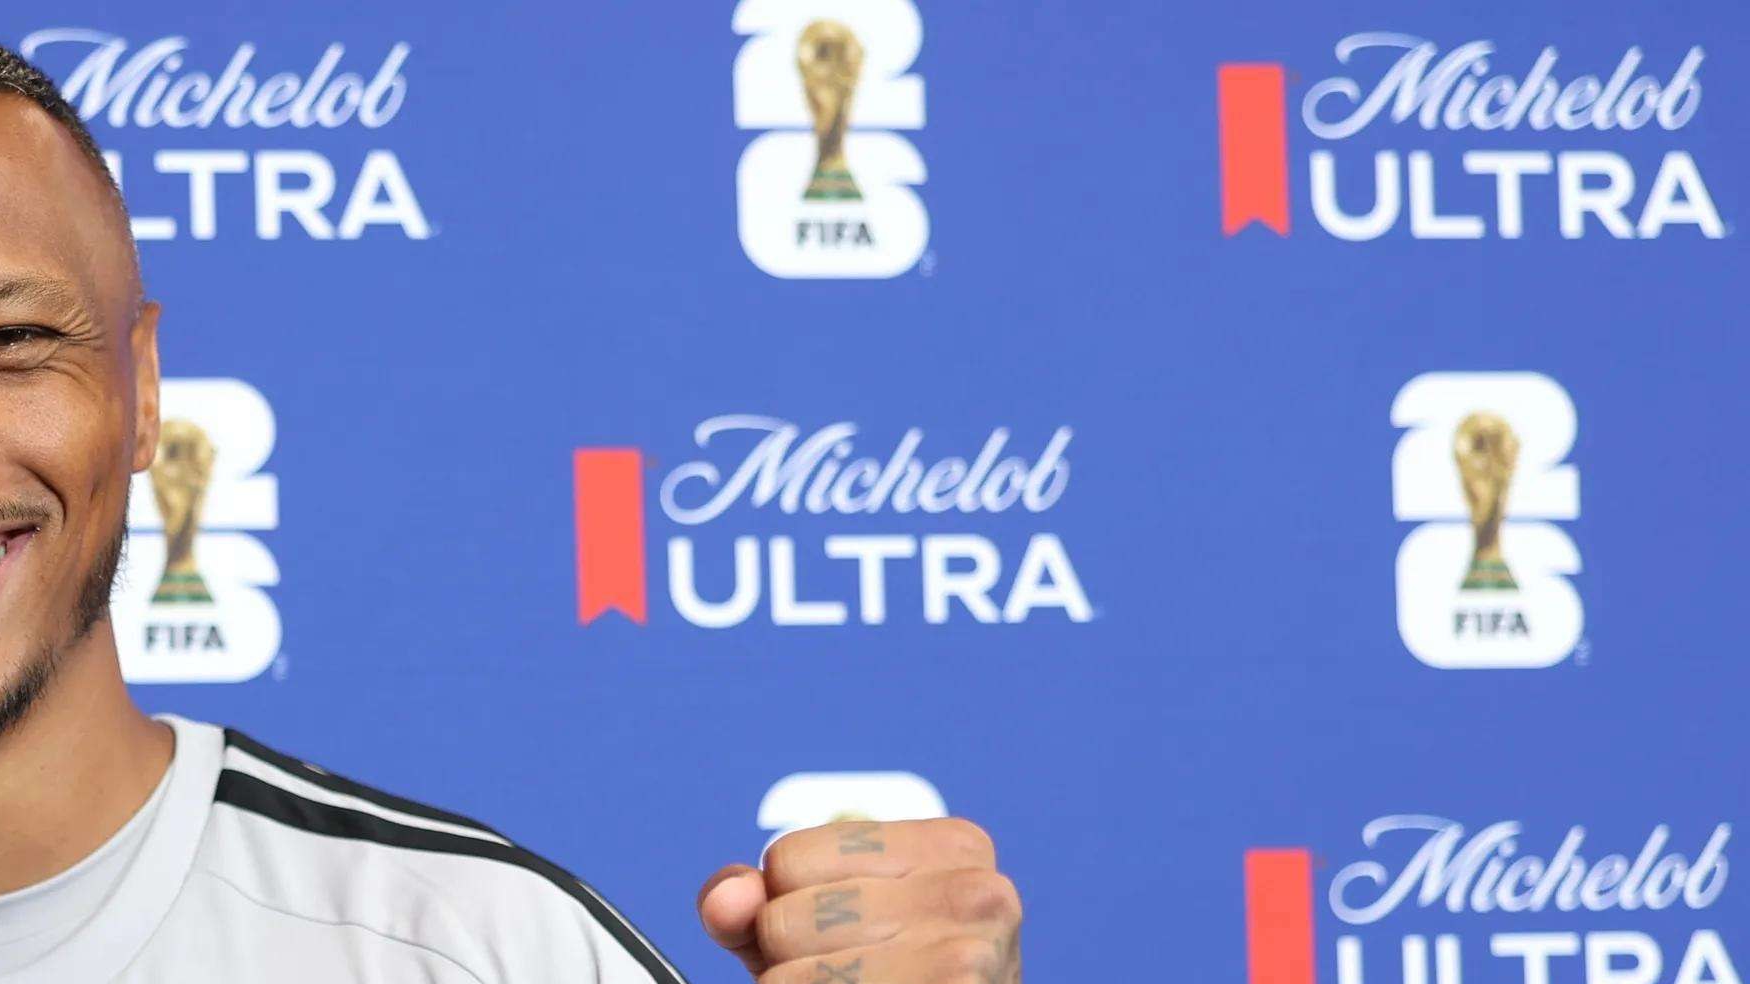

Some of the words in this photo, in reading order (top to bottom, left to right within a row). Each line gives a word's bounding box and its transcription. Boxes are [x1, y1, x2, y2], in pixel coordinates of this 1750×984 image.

[19, 27, 411, 129] Michelob
[1301, 31, 1706, 140] Michelob
[101, 149, 431, 241] LTRA
[795, 221, 876, 247] FIFA
[1308, 150, 1725, 242] ULTRA
[659, 414, 1074, 526] Michelob
[667, 533, 1094, 629] ULTRA
[1454, 609, 1531, 636] FIFA
[144, 623, 226, 651] FIFA
[1327, 813, 1733, 926] Michelob
